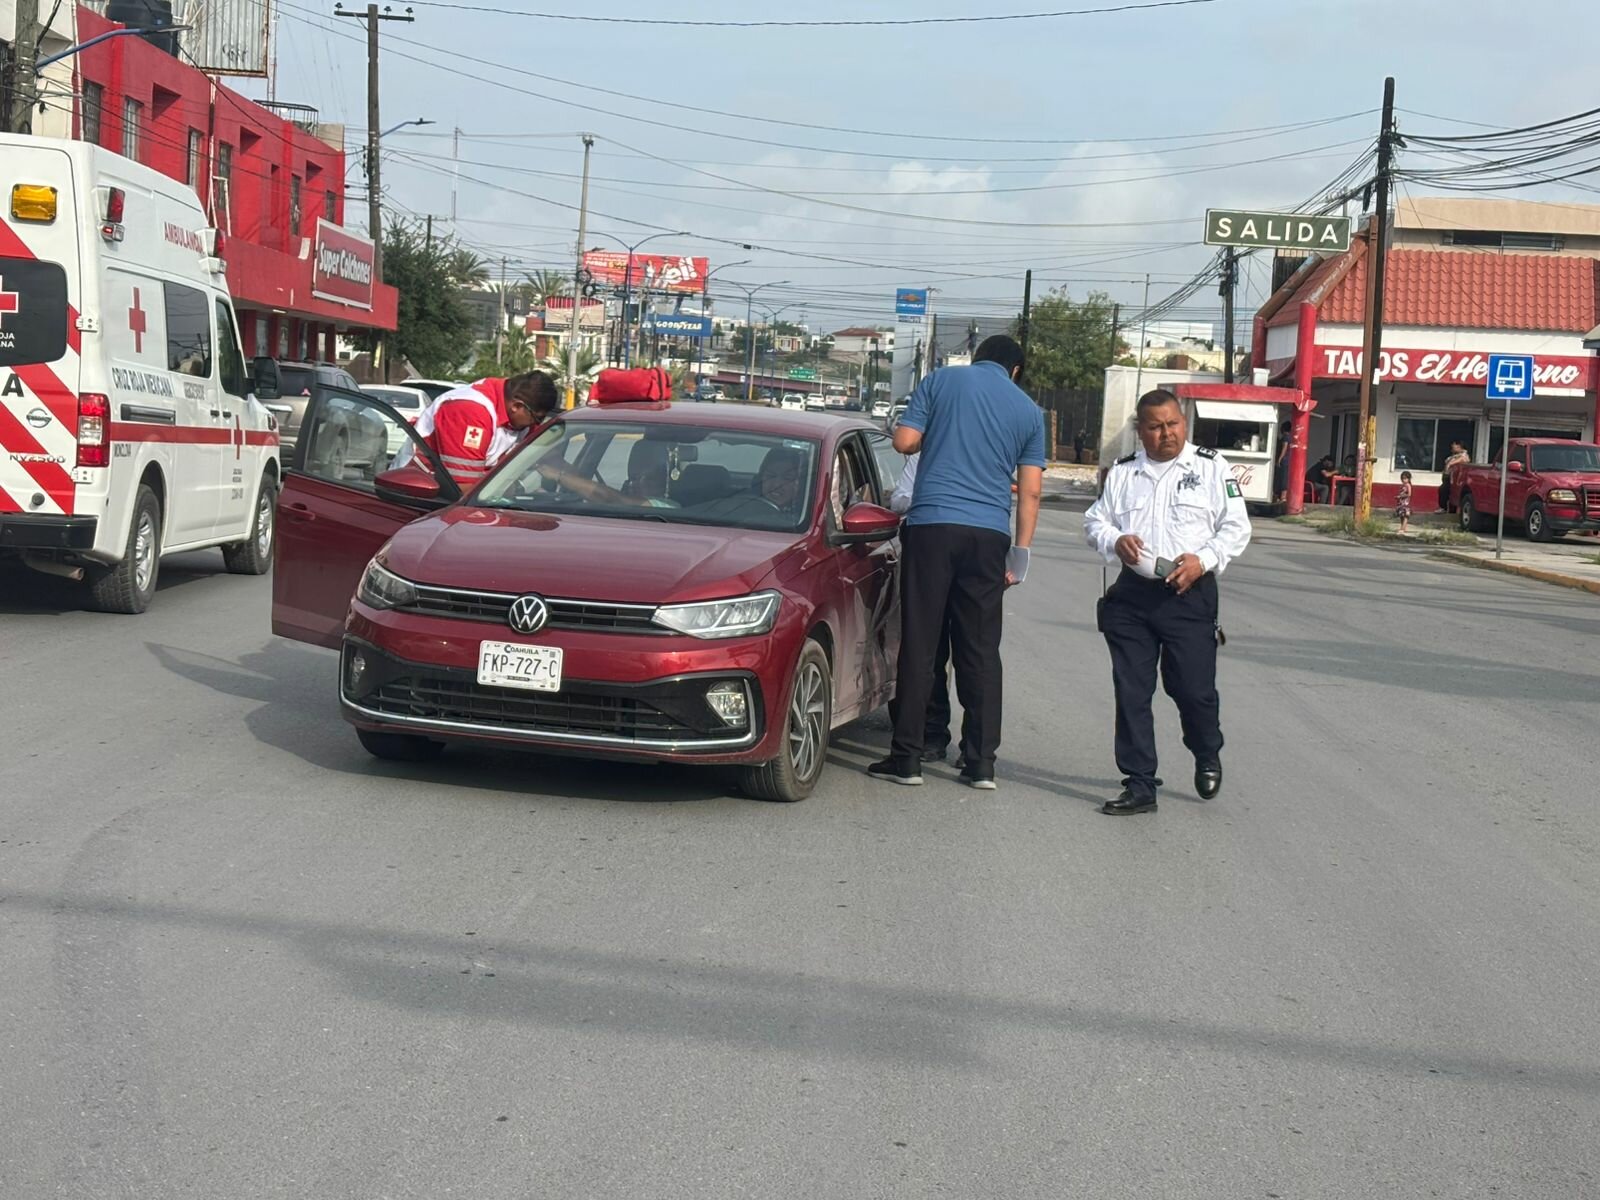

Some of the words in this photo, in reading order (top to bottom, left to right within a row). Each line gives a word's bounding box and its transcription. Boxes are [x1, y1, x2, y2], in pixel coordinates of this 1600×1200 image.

[1215, 217, 1339, 244] SALIDA
[319, 241, 340, 279] Super
[340, 249, 371, 285] Colchones
[656, 320, 703, 332] GOODYEAR
[1415, 353, 1452, 381] El
[482, 652, 558, 679] FKP-727-C
